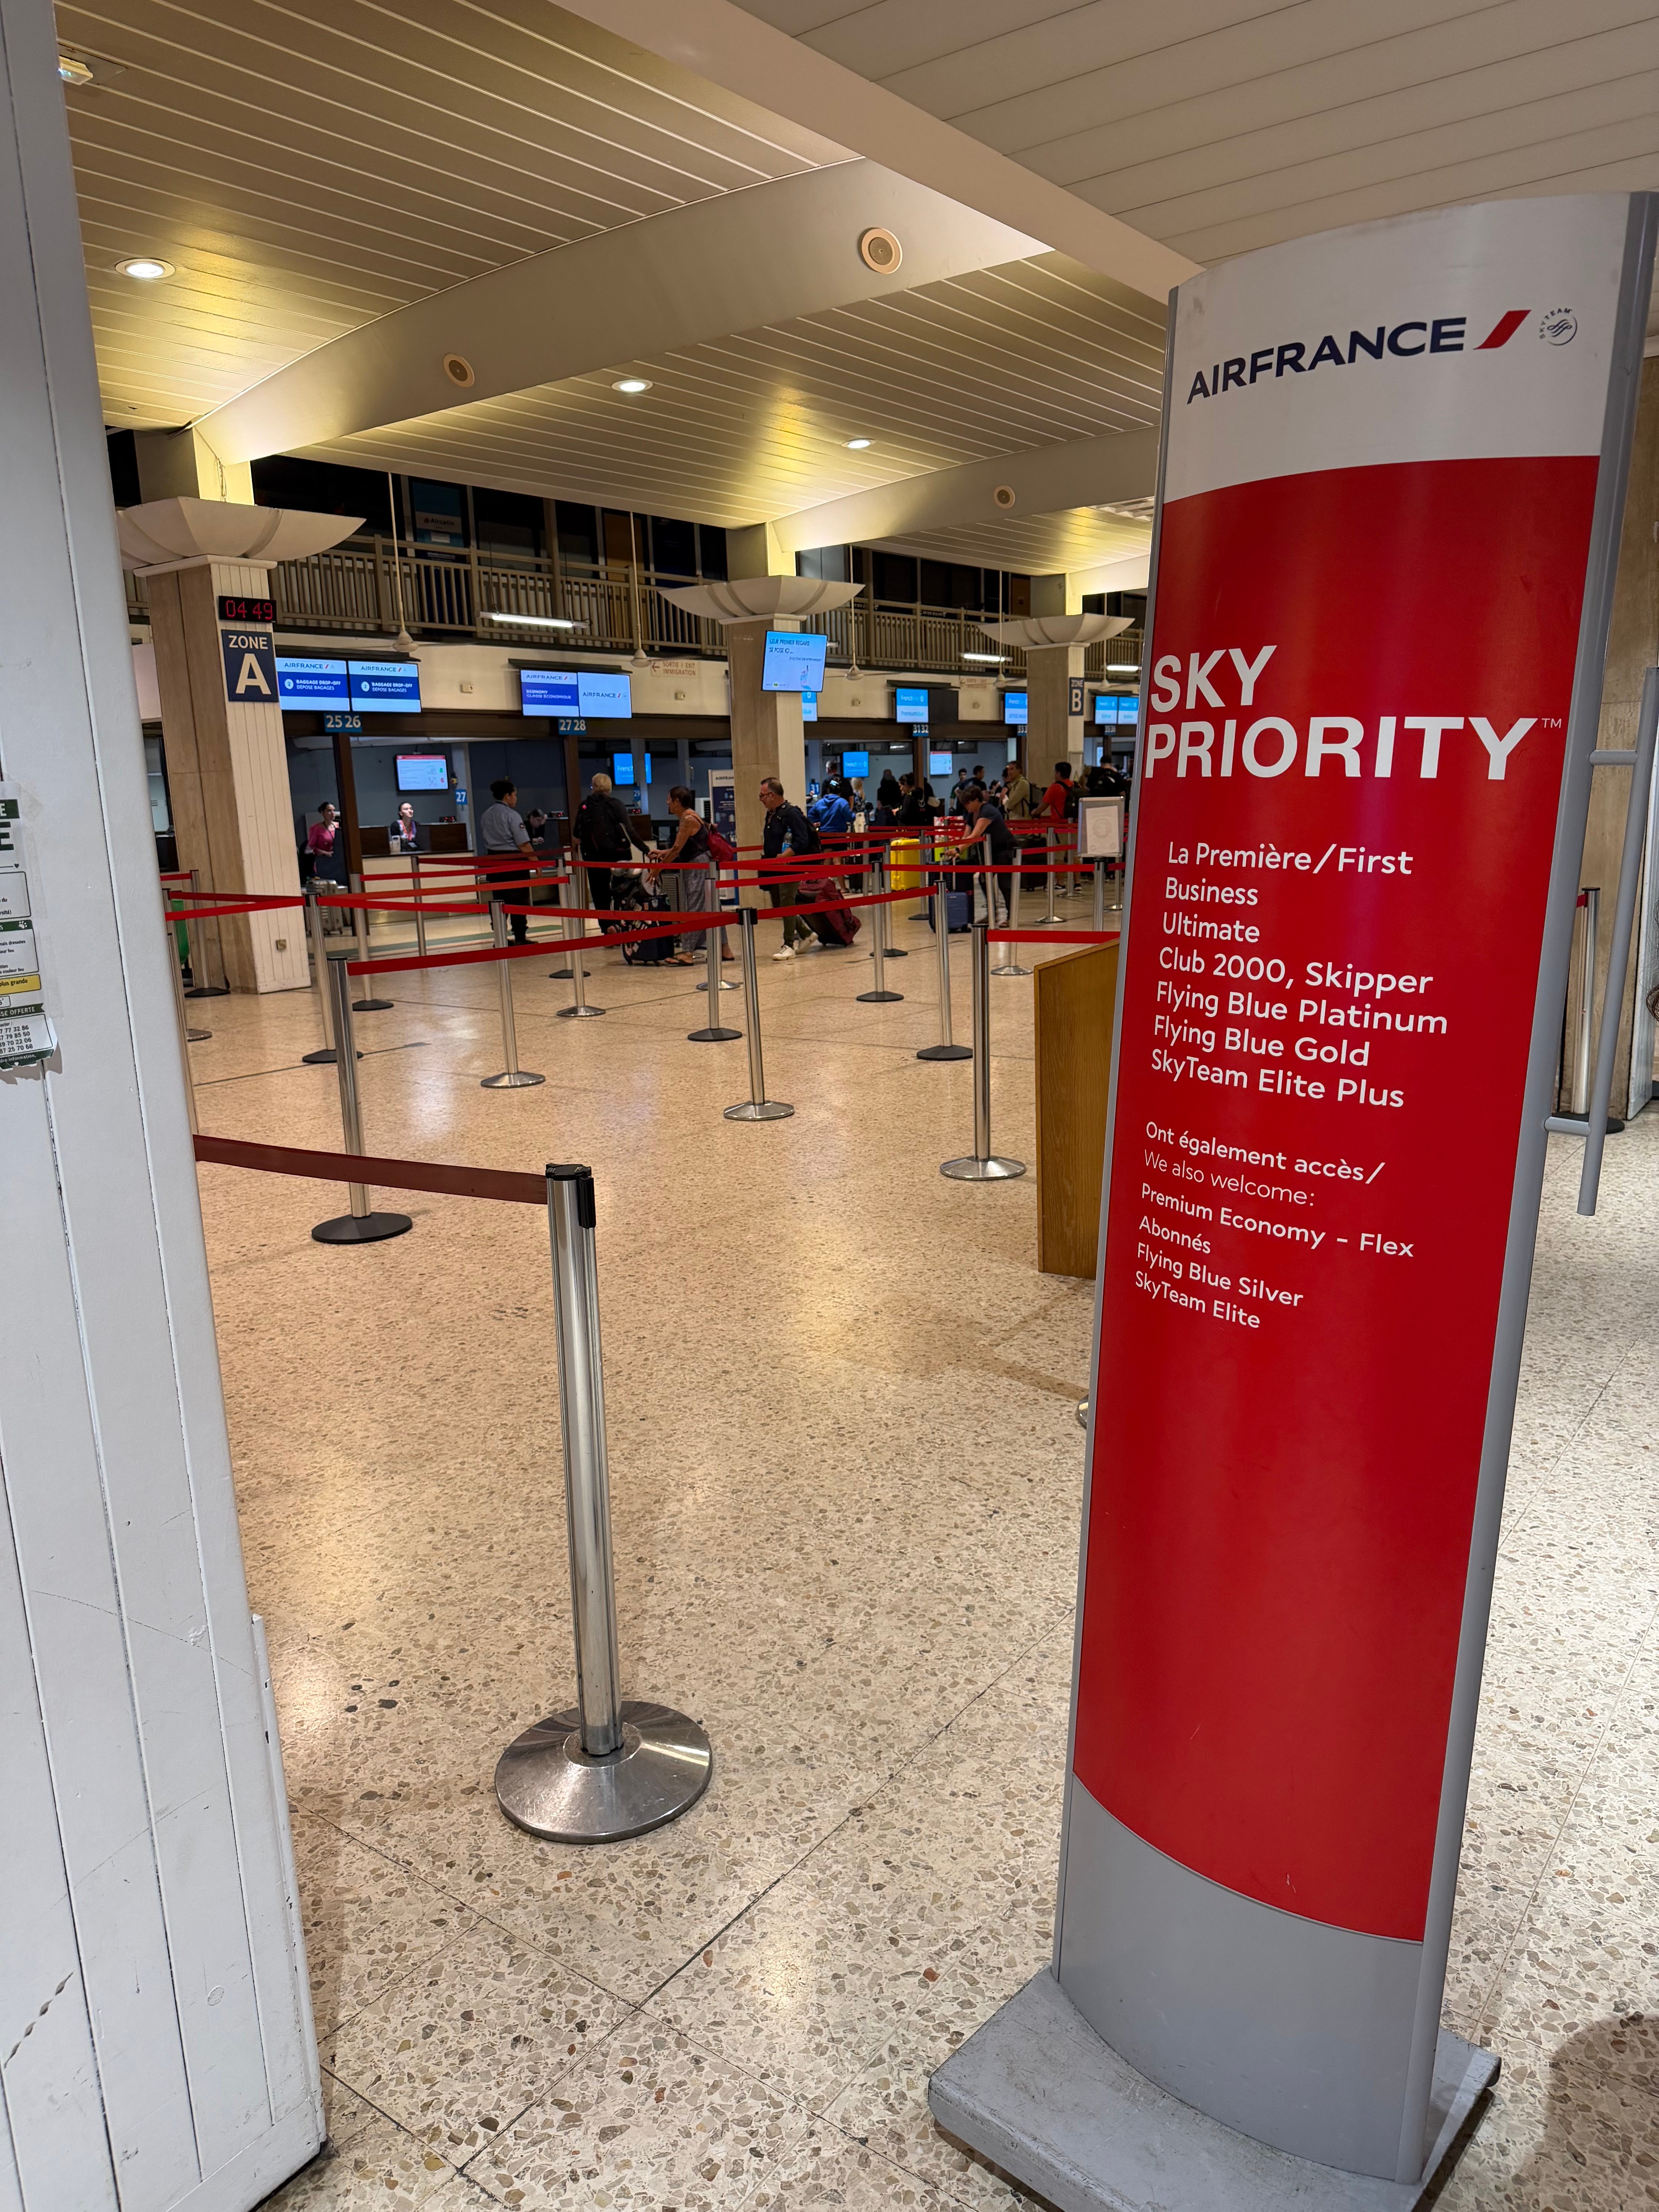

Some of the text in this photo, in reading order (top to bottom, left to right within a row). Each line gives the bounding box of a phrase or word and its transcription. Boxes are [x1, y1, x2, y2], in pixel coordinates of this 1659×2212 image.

[1187, 317, 1467, 405] AIRFRANCE
[226, 600, 273, 620] 04 49
[228, 635, 268, 649] ZONE
[235, 653, 272, 695] A
[1151, 645, 1277, 713] SKY
[326, 715, 361, 728] 25 26
[1072, 689, 1082, 712] B
[560, 719, 586, 731] 27 28
[1145, 716, 1538, 780] PRIORITY
[455, 792, 466, 802] 27
[1168, 842, 1189, 864] La
[1165, 877, 1259, 905] Business
[1163, 911, 1260, 943] Ultimate
[1159, 946, 1434, 1000] Club 2000, Skipper
[10, 1006, 35, 1015] OFFERTE
[1157, 981, 1448, 1034] Flying Blue Platinum
[1154, 1015, 1370, 1066] Flying Blue Gold
[1151, 1049, 1405, 1108] SkyTeam Elite Plus
[1146, 1121, 1386, 1185] Ont également accès/
[1145, 1149, 1315, 1207] We also welcome:
[1139, 1216, 1211, 1254] Abonnés
[1142, 1183, 1213, 1221] Premium
[1220, 1207, 1326, 1250] Economy
[1360, 1233, 1415, 1258] Flex
[1138, 1242, 1304, 1307] Flying Blue Silver
[1135, 1271, 1261, 1329] SkyTeam Elite
